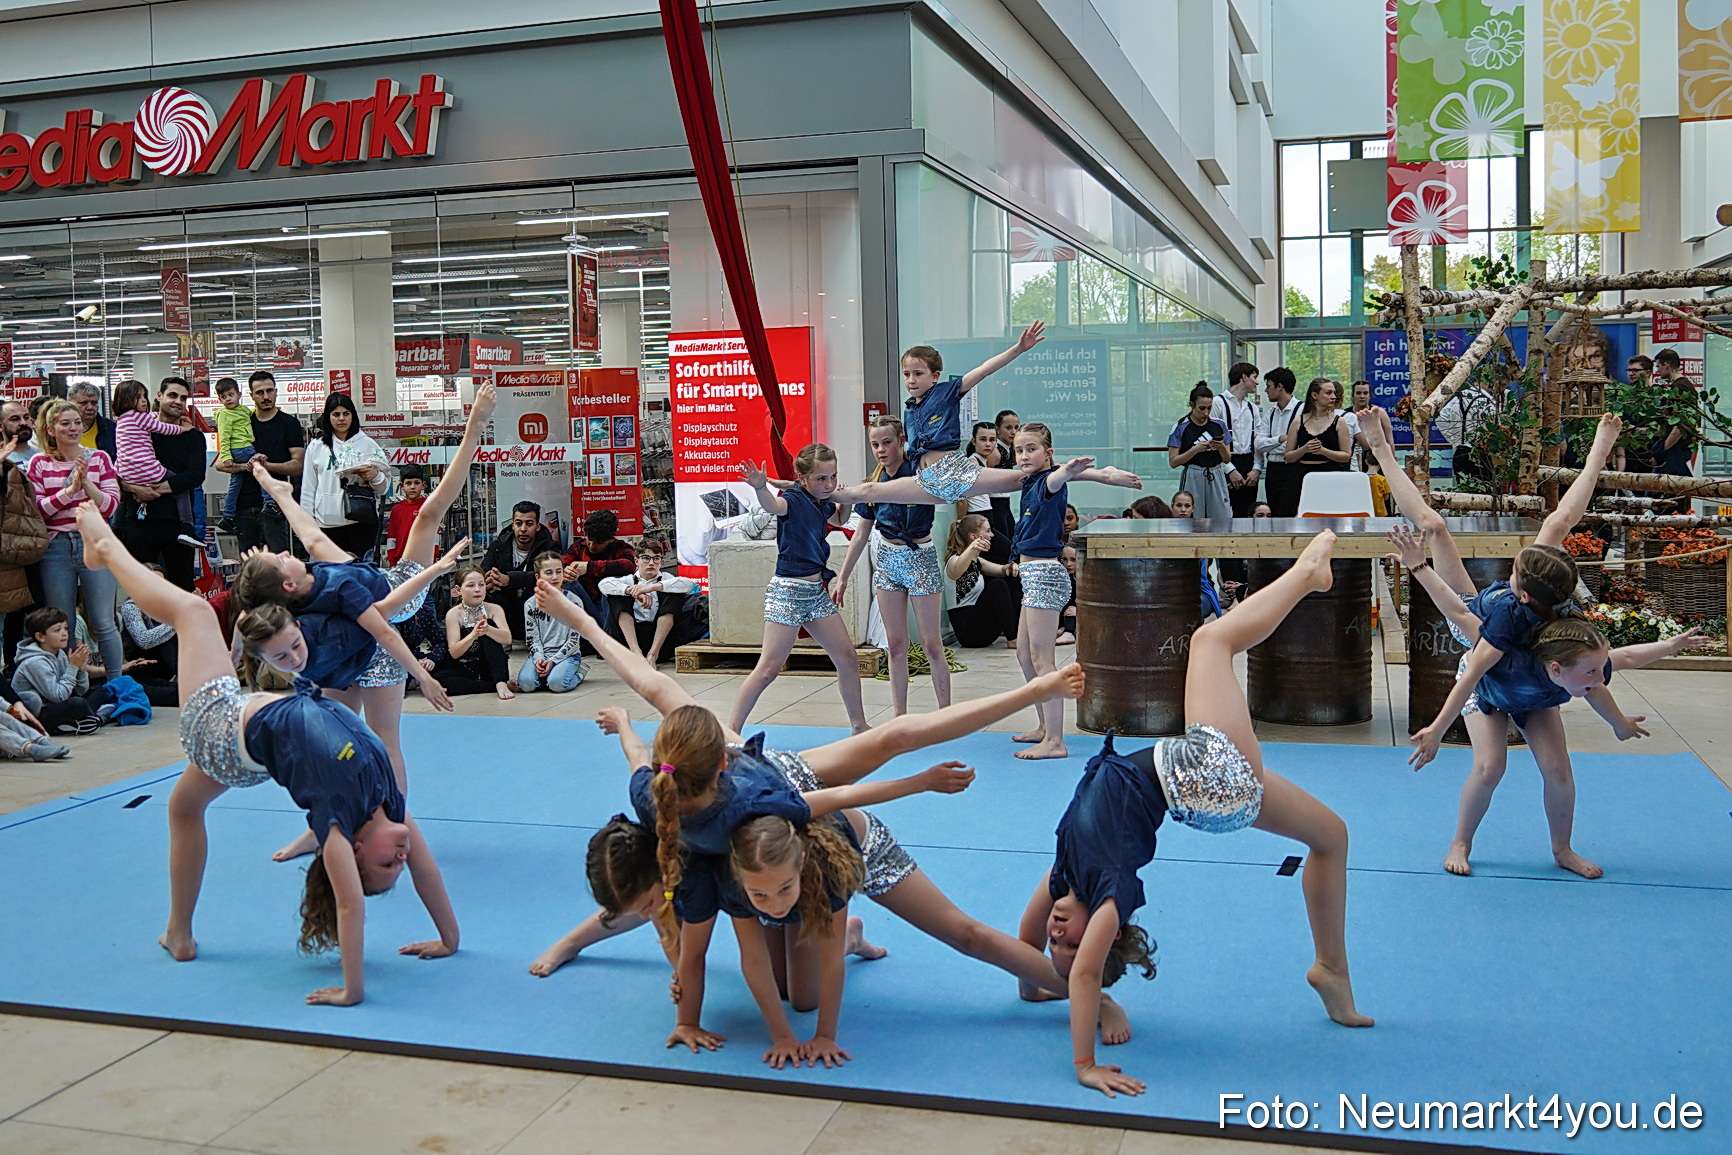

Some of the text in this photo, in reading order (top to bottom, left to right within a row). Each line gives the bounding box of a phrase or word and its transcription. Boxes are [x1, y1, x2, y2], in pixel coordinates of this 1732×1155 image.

[0, 74, 450, 192] edia Markt
[674, 342, 726, 353] MediaMarkt
[1374, 339, 1395, 352] Ich
[475, 345, 513, 361] Smartbar
[1374, 354, 1401, 367] den
[1684, 361, 1703, 374] REWE
[499, 374, 530, 385] Media
[1374, 370, 1411, 381] Ferns
[15, 388, 38, 400] UND
[512, 390, 551, 398] PRÄSENTIERT
[676, 381, 806, 400] für Smartpnes
[1374, 383, 1398, 396] der
[571, 393, 631, 406] Vorbesteller
[676, 403, 736, 413] hier im Markt.
[683, 423, 738, 433] Displayschutz
[683, 436, 739, 447] Displaytausch
[389, 447, 431, 464] Markt
[520, 444, 566, 462] Markt
[683, 450, 730, 460] Akkutausch
[501, 470, 520, 478] Redmi
[521, 469, 539, 477] Note
[550, 468, 567, 476] Series
[684, 463, 747, 473] und vieles meh
[1158, 635, 1190, 655] AR
